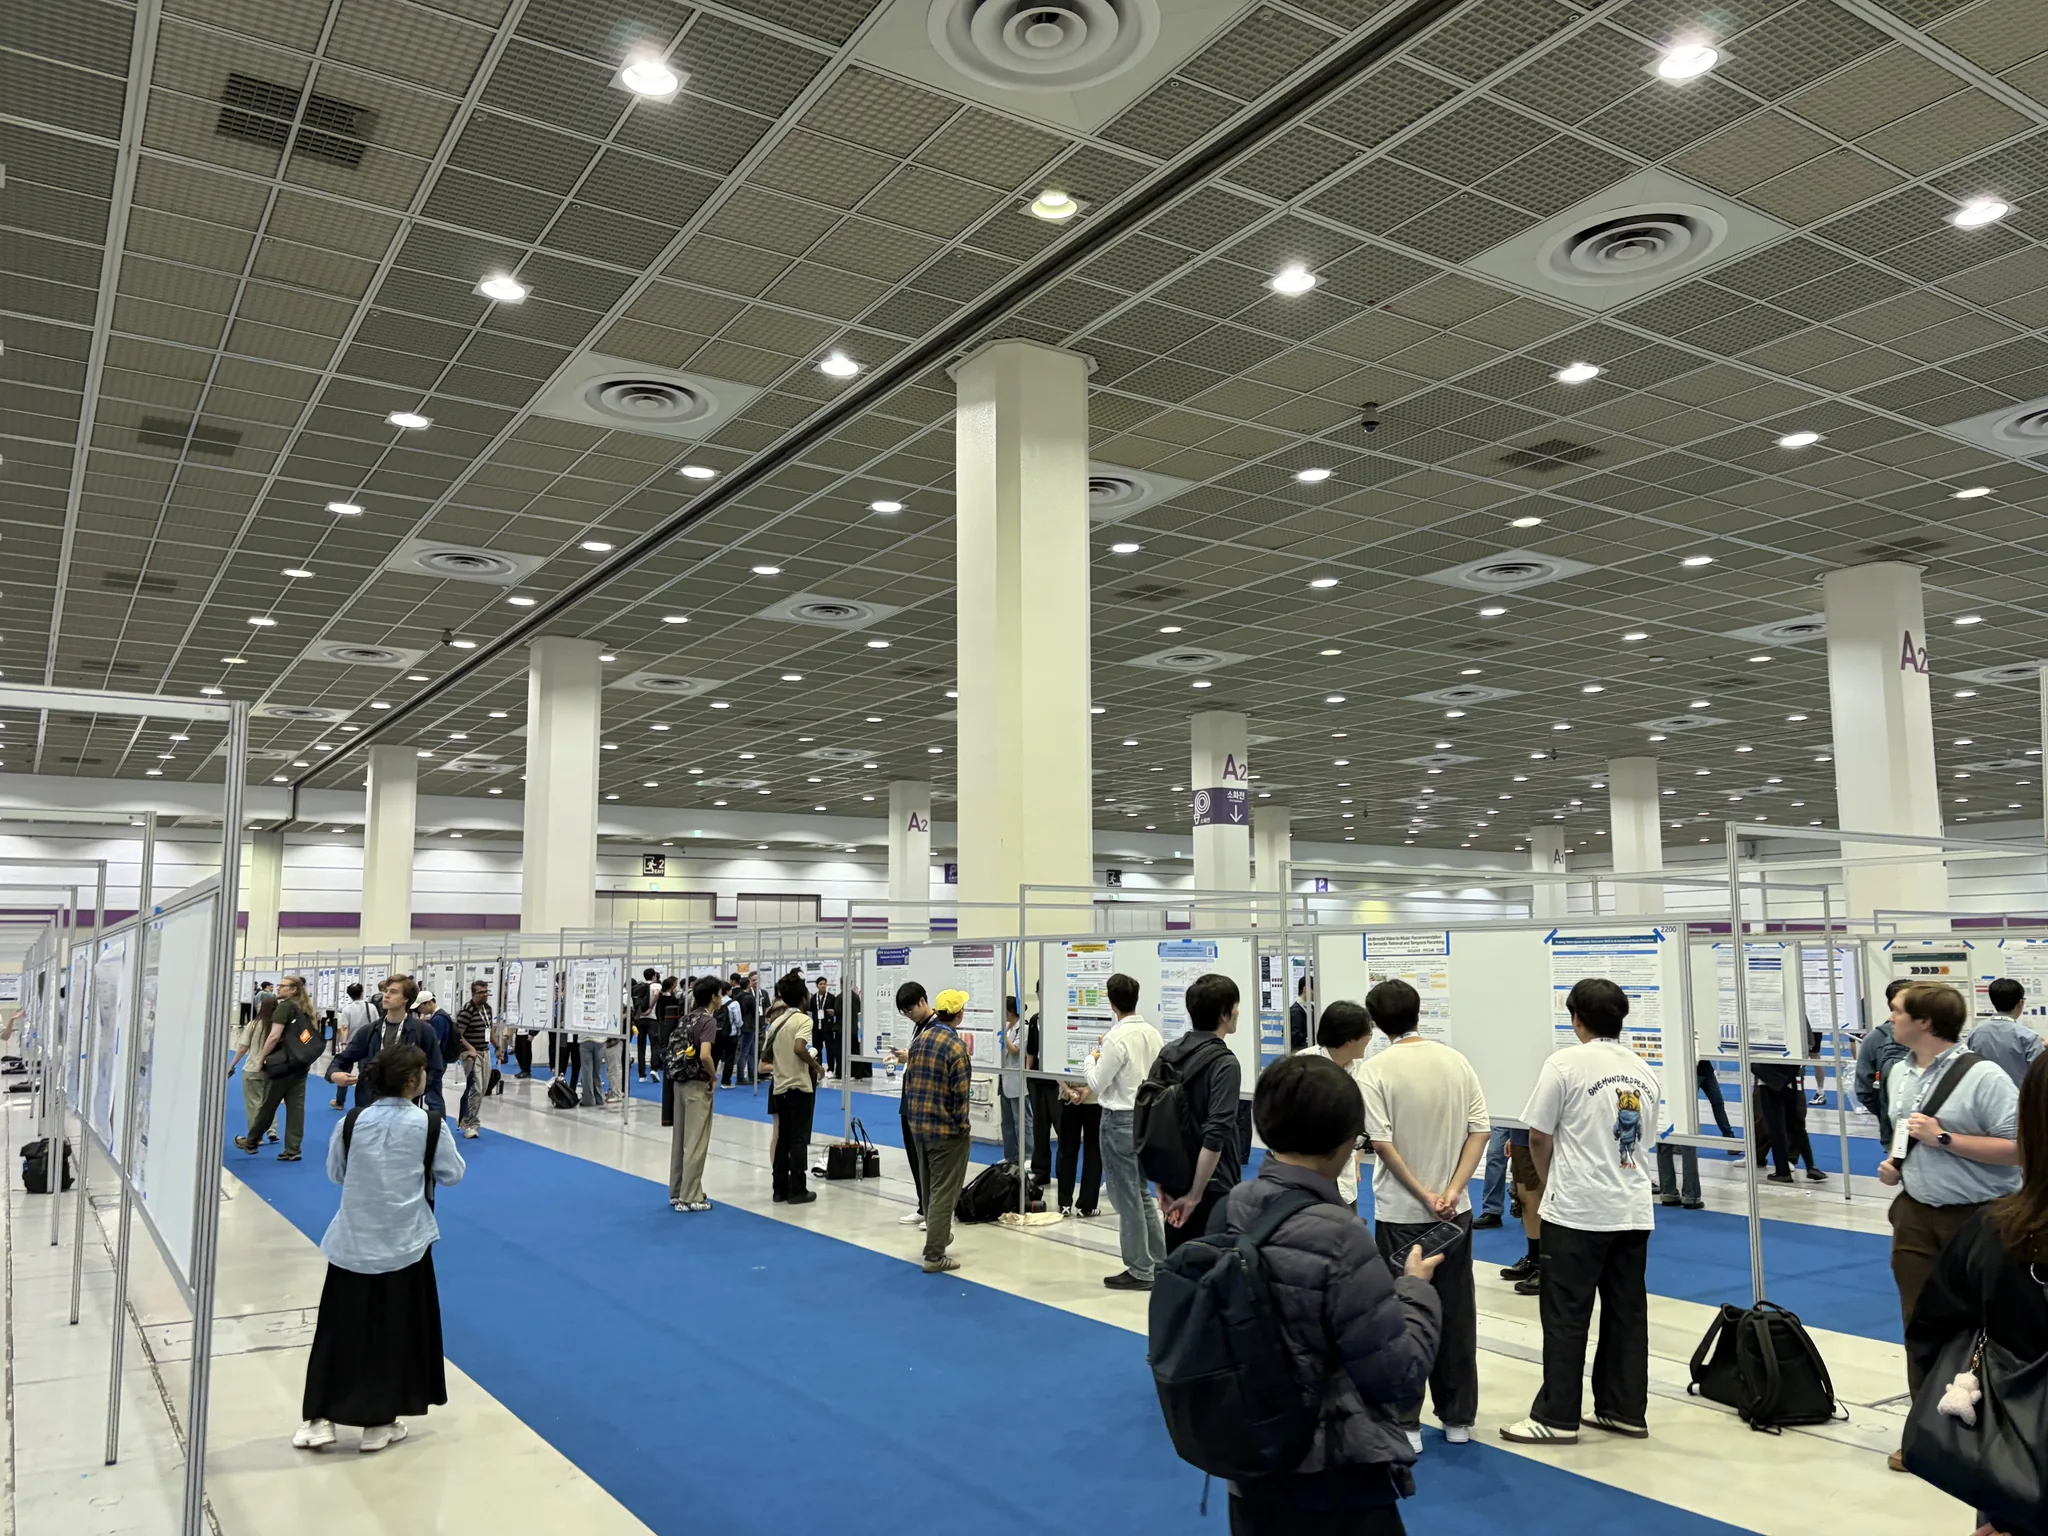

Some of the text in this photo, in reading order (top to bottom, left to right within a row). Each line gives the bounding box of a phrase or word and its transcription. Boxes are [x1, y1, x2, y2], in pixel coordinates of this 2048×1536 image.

[1901, 630, 1929, 675] A2
[1222, 753, 1247, 781] A2
[1226, 790, 1245, 800] 소화전
[907, 811, 928, 832] A2
[659, 859, 665, 868] 2
[1553, 848, 1564, 864] A1
